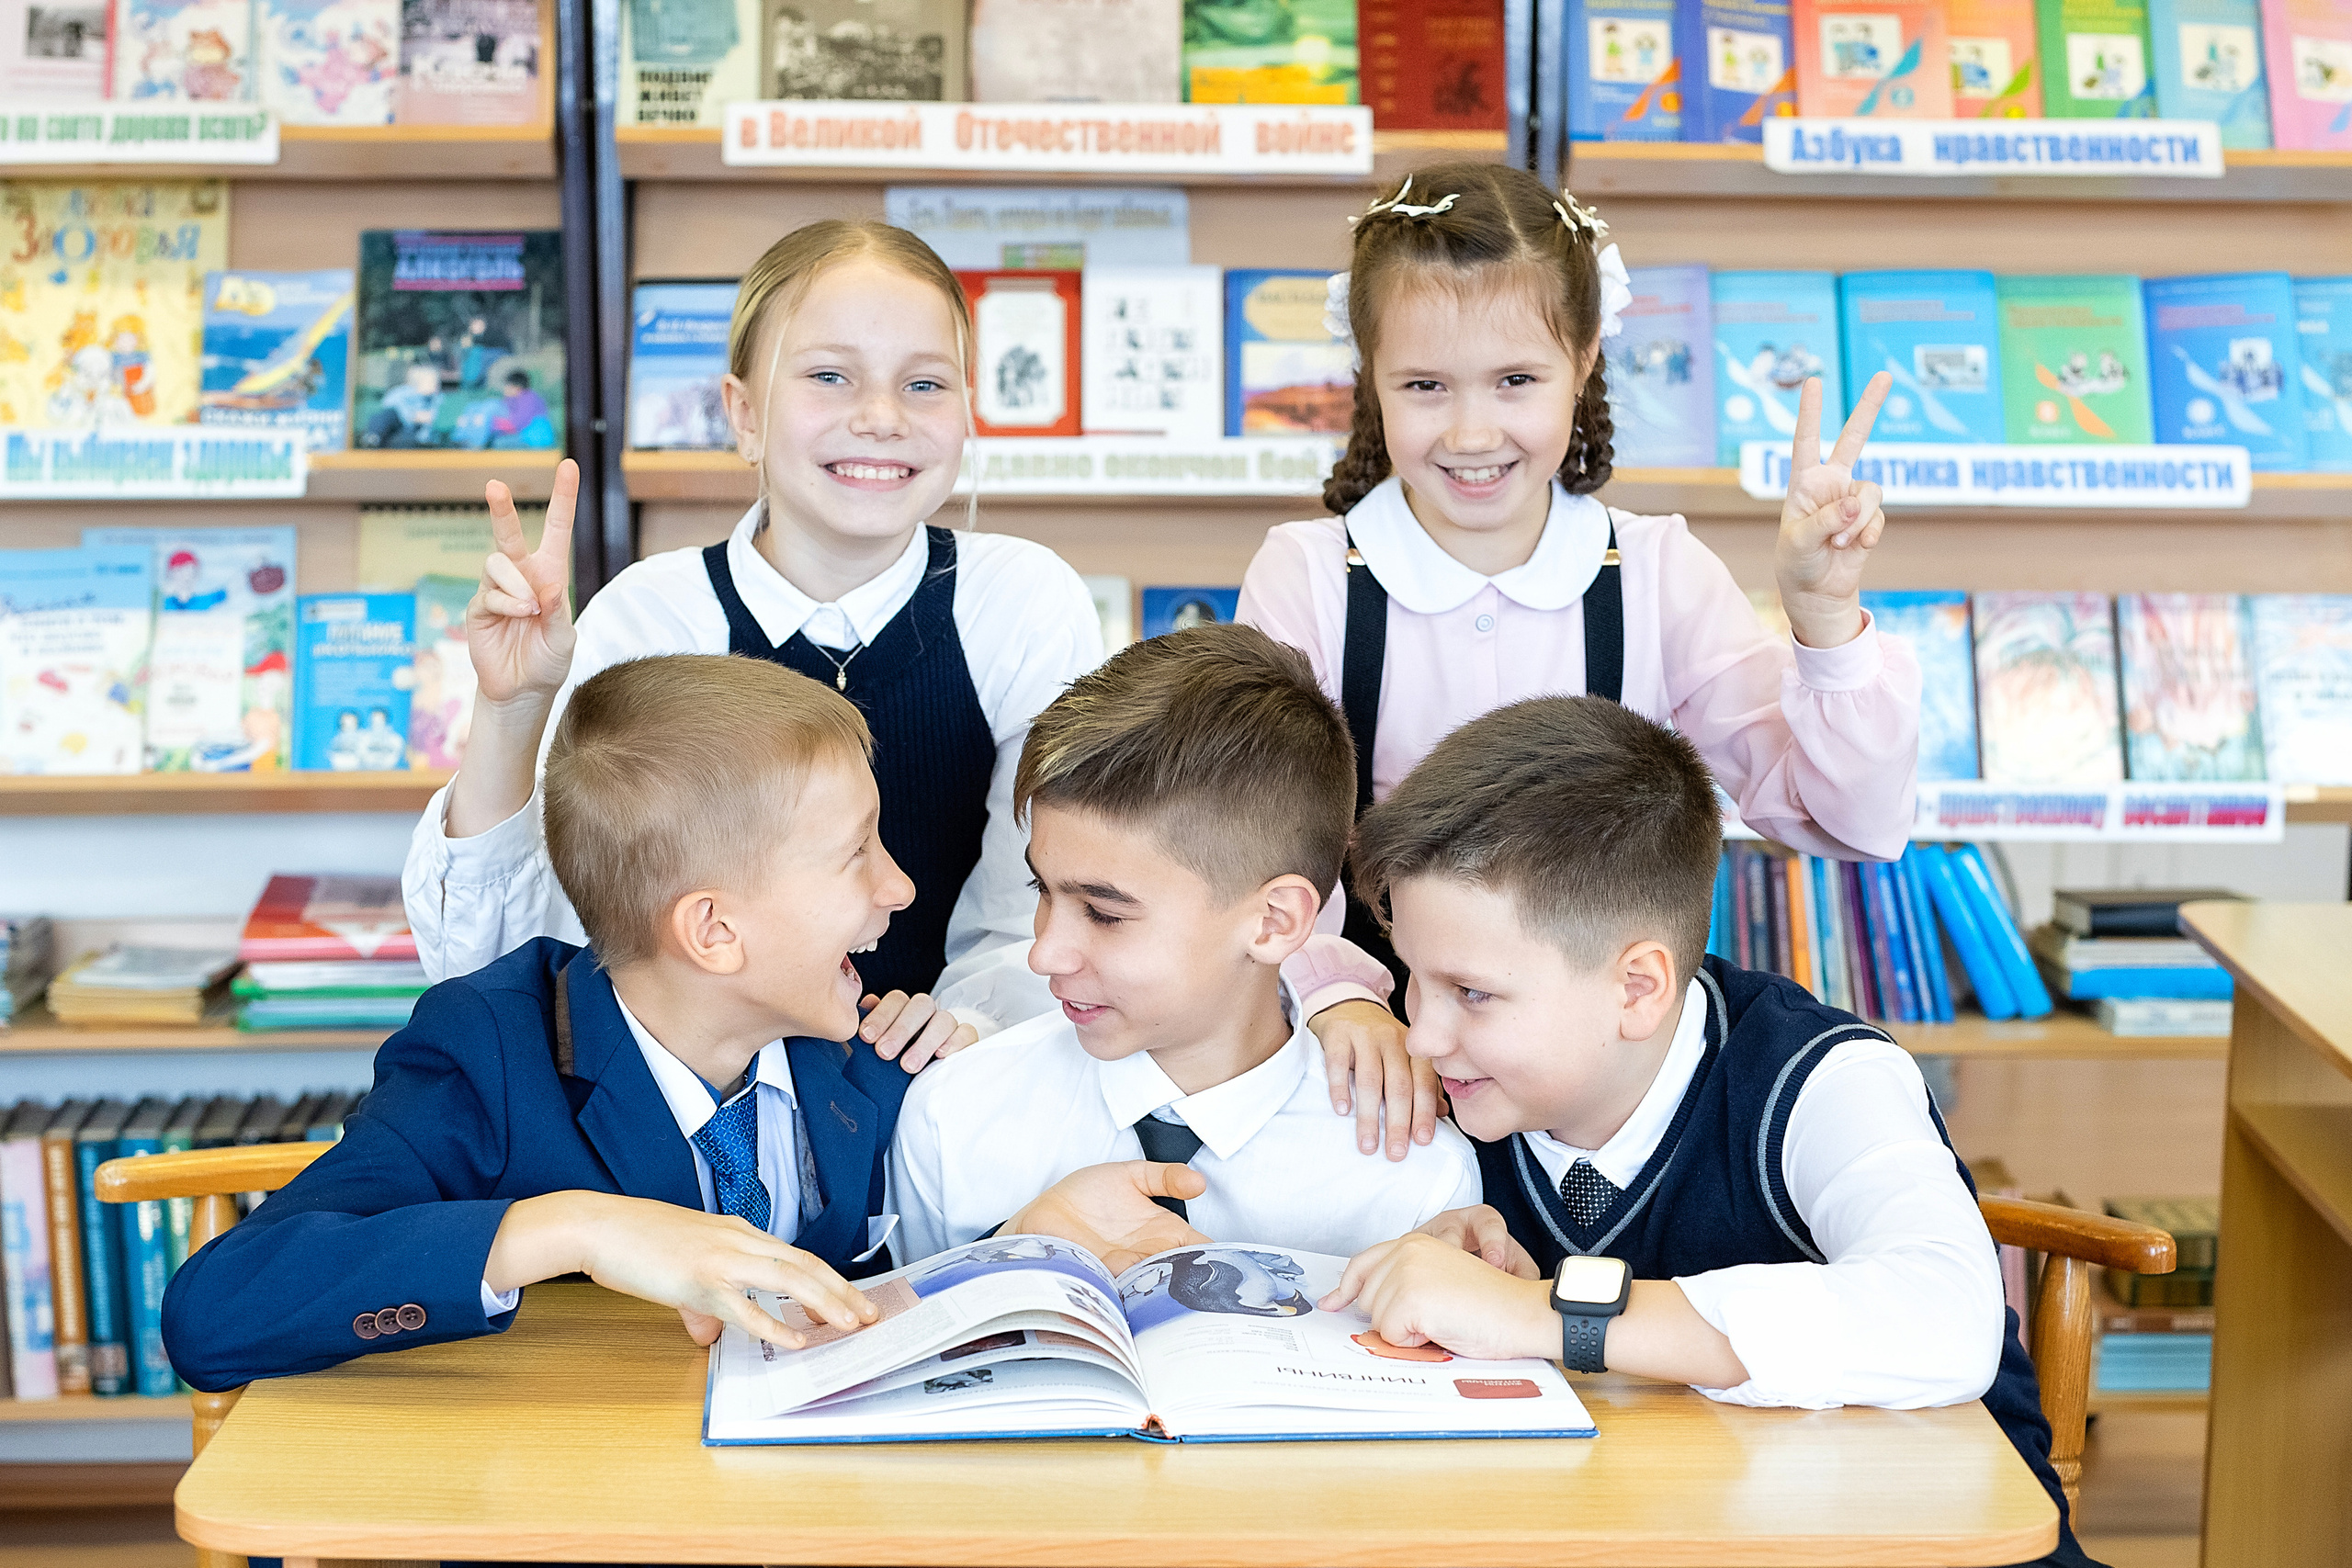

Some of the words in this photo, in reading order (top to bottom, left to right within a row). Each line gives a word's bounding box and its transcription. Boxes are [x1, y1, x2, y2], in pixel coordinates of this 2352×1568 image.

[741, 118, 757, 148] в
[769, 107, 922, 150] Великой
[956, 110, 1222, 154] Отечественной
[1255, 110, 1356, 154] войне
[1790, 127, 1903, 169] Азбука
[1933, 132, 2201, 170] нравственности
[1972, 455, 2235, 493] нравственности
[1275, 1365, 1427, 1385] ПИНГВИНЫ
